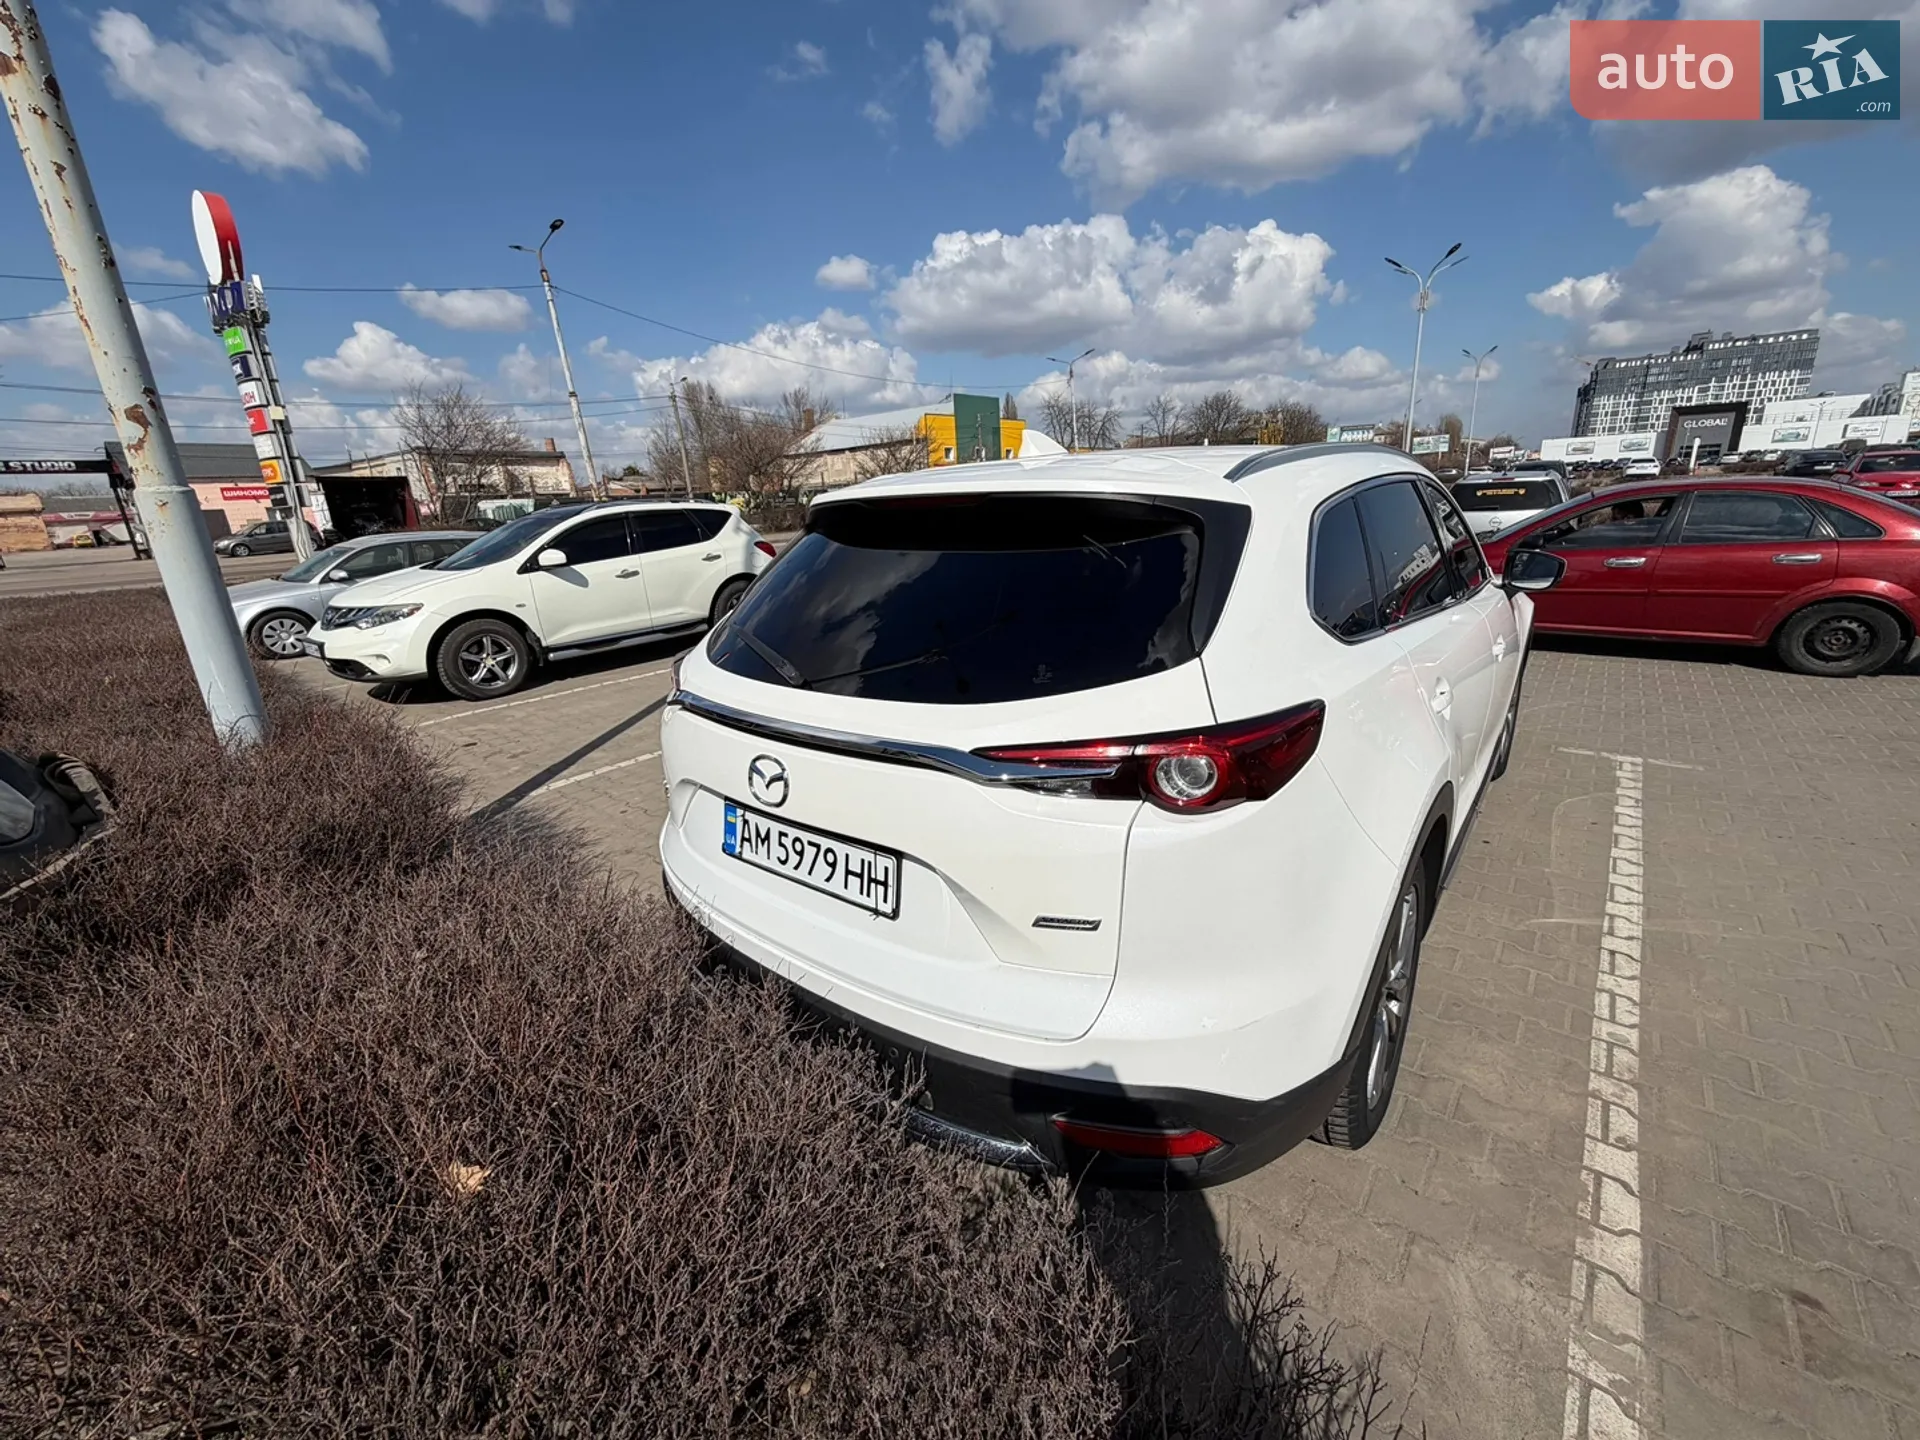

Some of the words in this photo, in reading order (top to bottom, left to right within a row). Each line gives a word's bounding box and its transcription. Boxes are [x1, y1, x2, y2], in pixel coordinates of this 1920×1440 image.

[1683, 417, 1728, 428] GLOBAL
[8, 461, 76, 471] STUDIO
[725, 833, 736, 846] UA
[740, 818, 771, 860] AM
[777, 830, 837, 883] 5979
[844, 852, 889, 904] HH
